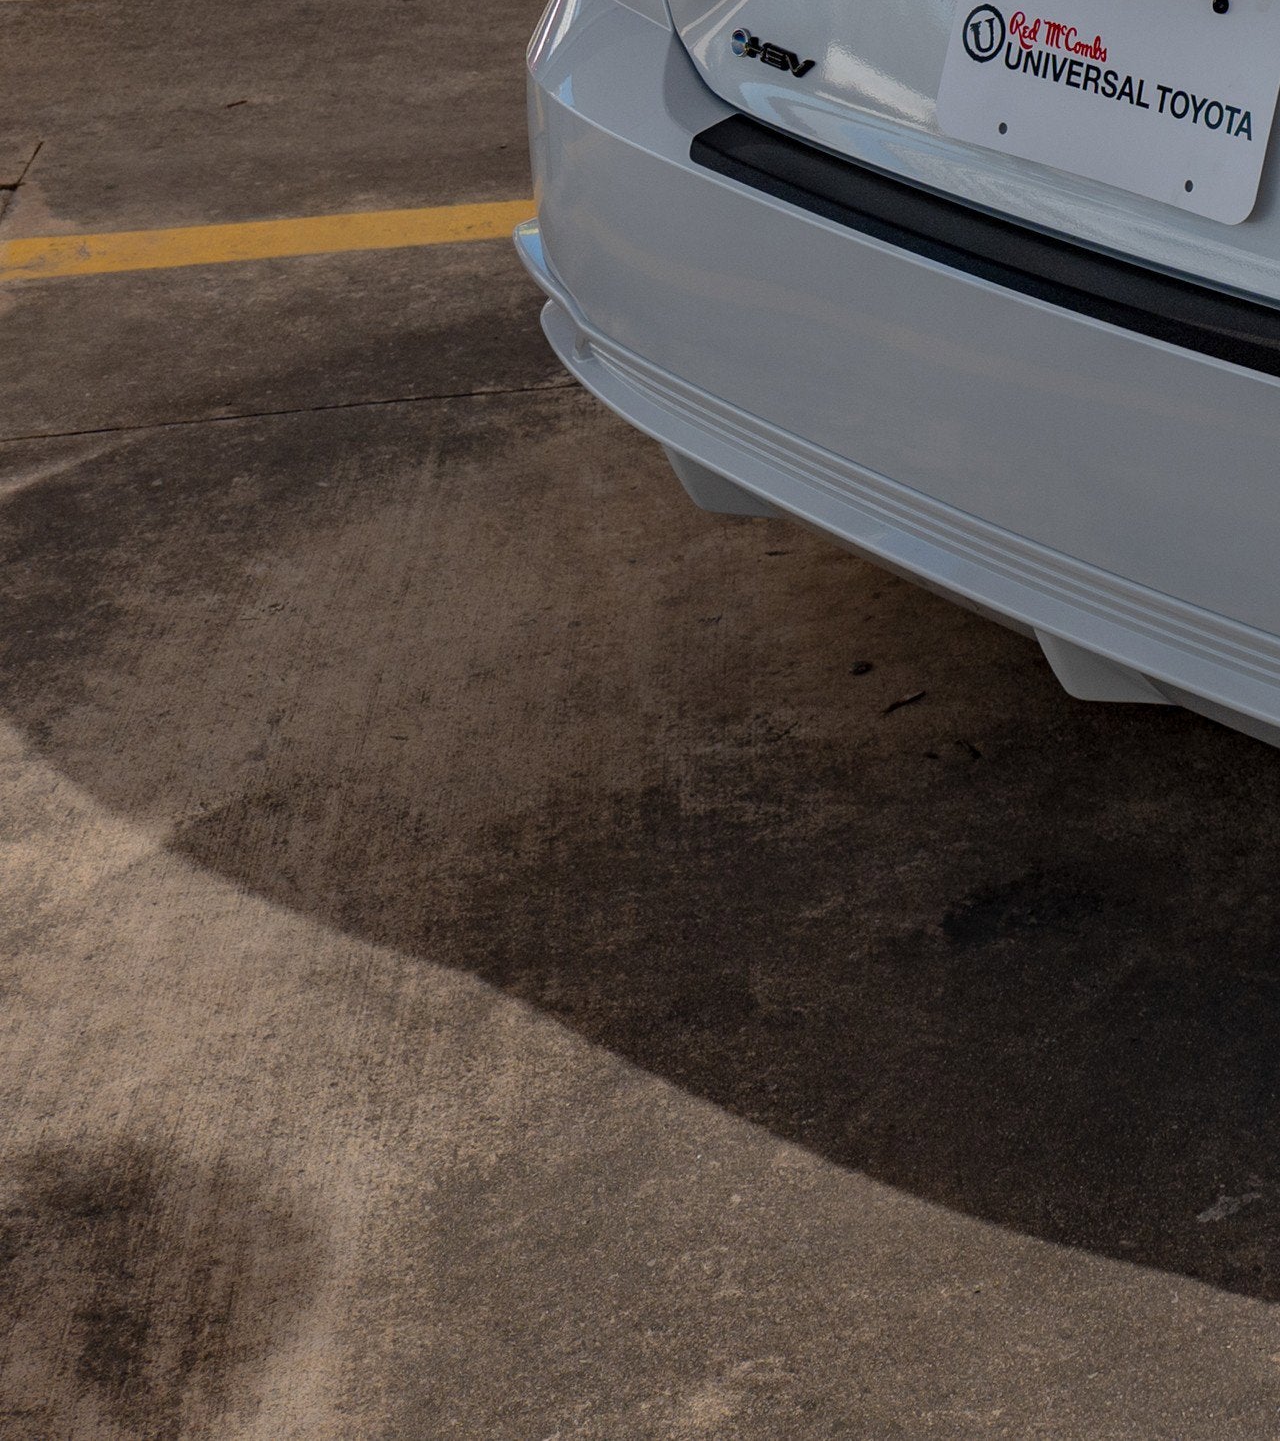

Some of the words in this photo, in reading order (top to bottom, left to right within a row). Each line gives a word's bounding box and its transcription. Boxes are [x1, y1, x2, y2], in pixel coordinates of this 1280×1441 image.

[1009, 10, 1041, 50] Red
[1044, 18, 1108, 63] McCombs
[1004, 40, 1151, 110] UNIVERSAL
[1156, 83, 1253, 141] TOYOTA
